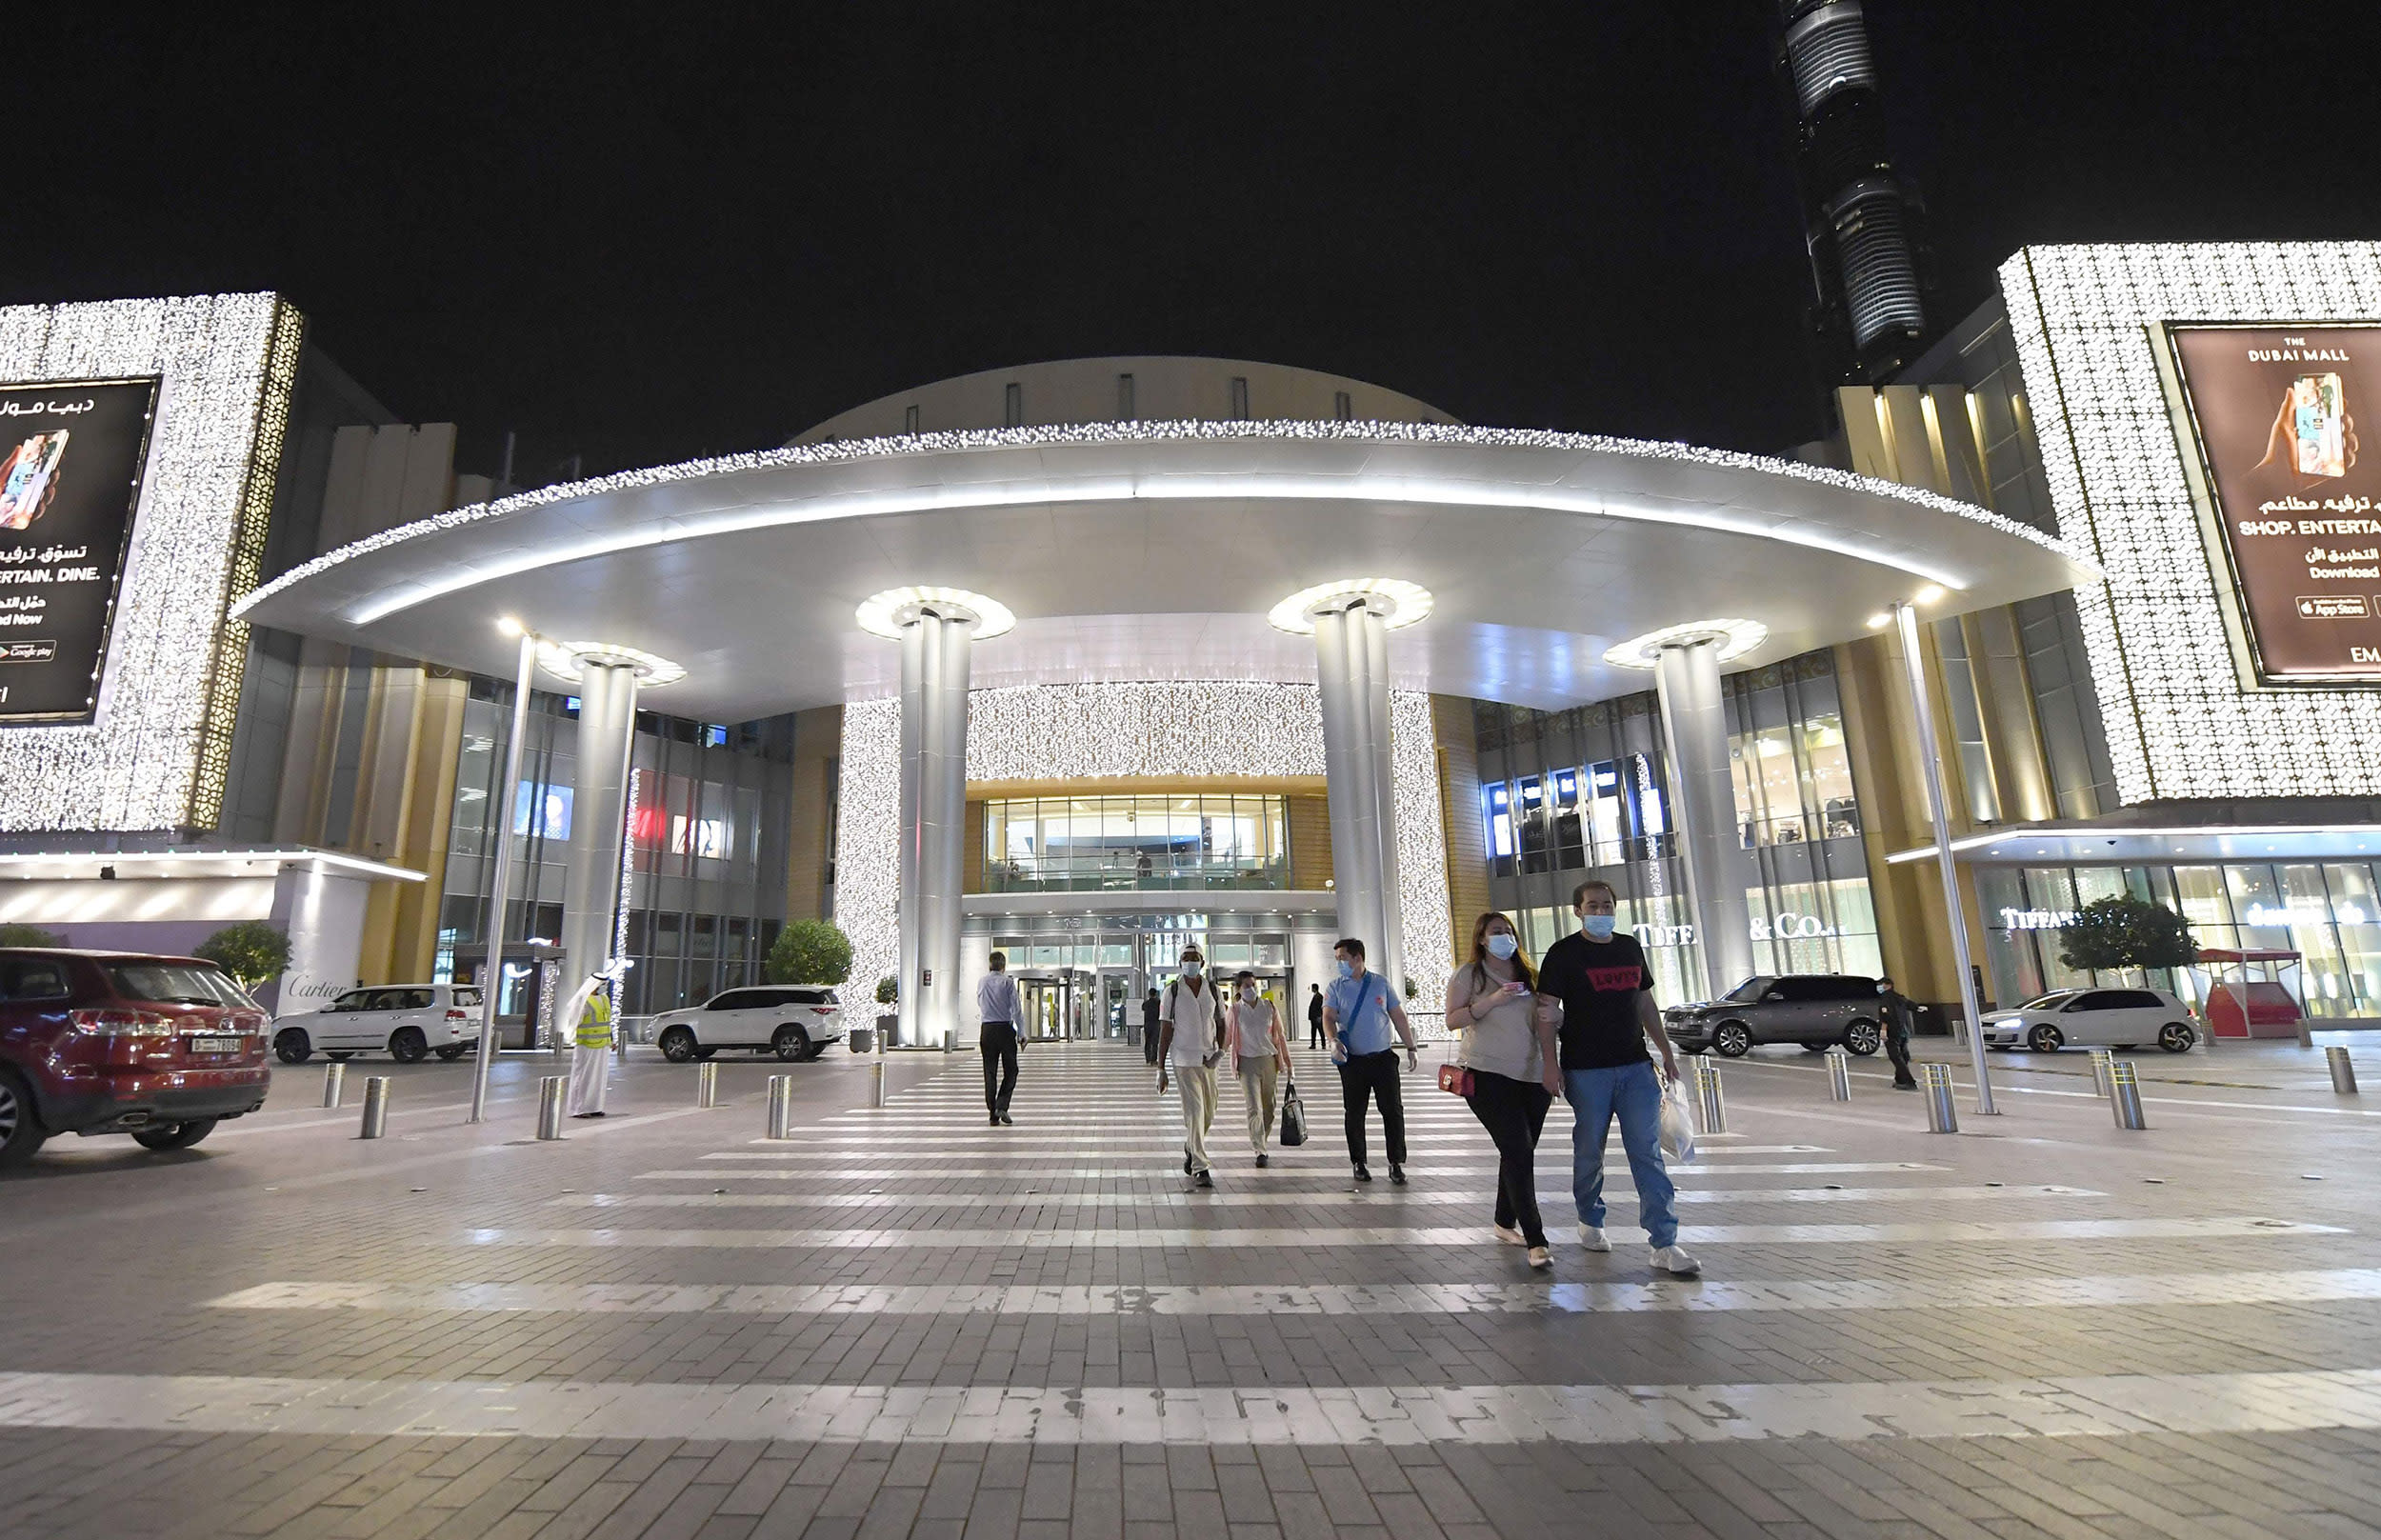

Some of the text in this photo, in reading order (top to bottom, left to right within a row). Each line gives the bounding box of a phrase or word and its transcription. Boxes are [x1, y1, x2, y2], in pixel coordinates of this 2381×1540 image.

[2284, 337, 2306, 346] THE
[2248, 349, 2350, 362] DUBAI MALL
[2238, 520, 2296, 535] SHOP.
[57, 567, 101, 583] DINE.
[2309, 566, 2381, 579] Download
[2315, 604, 2337, 616] App
[12, 613, 43, 626] Now
[1750, 917, 1772, 941] &
[289, 972, 348, 998] Cartier
